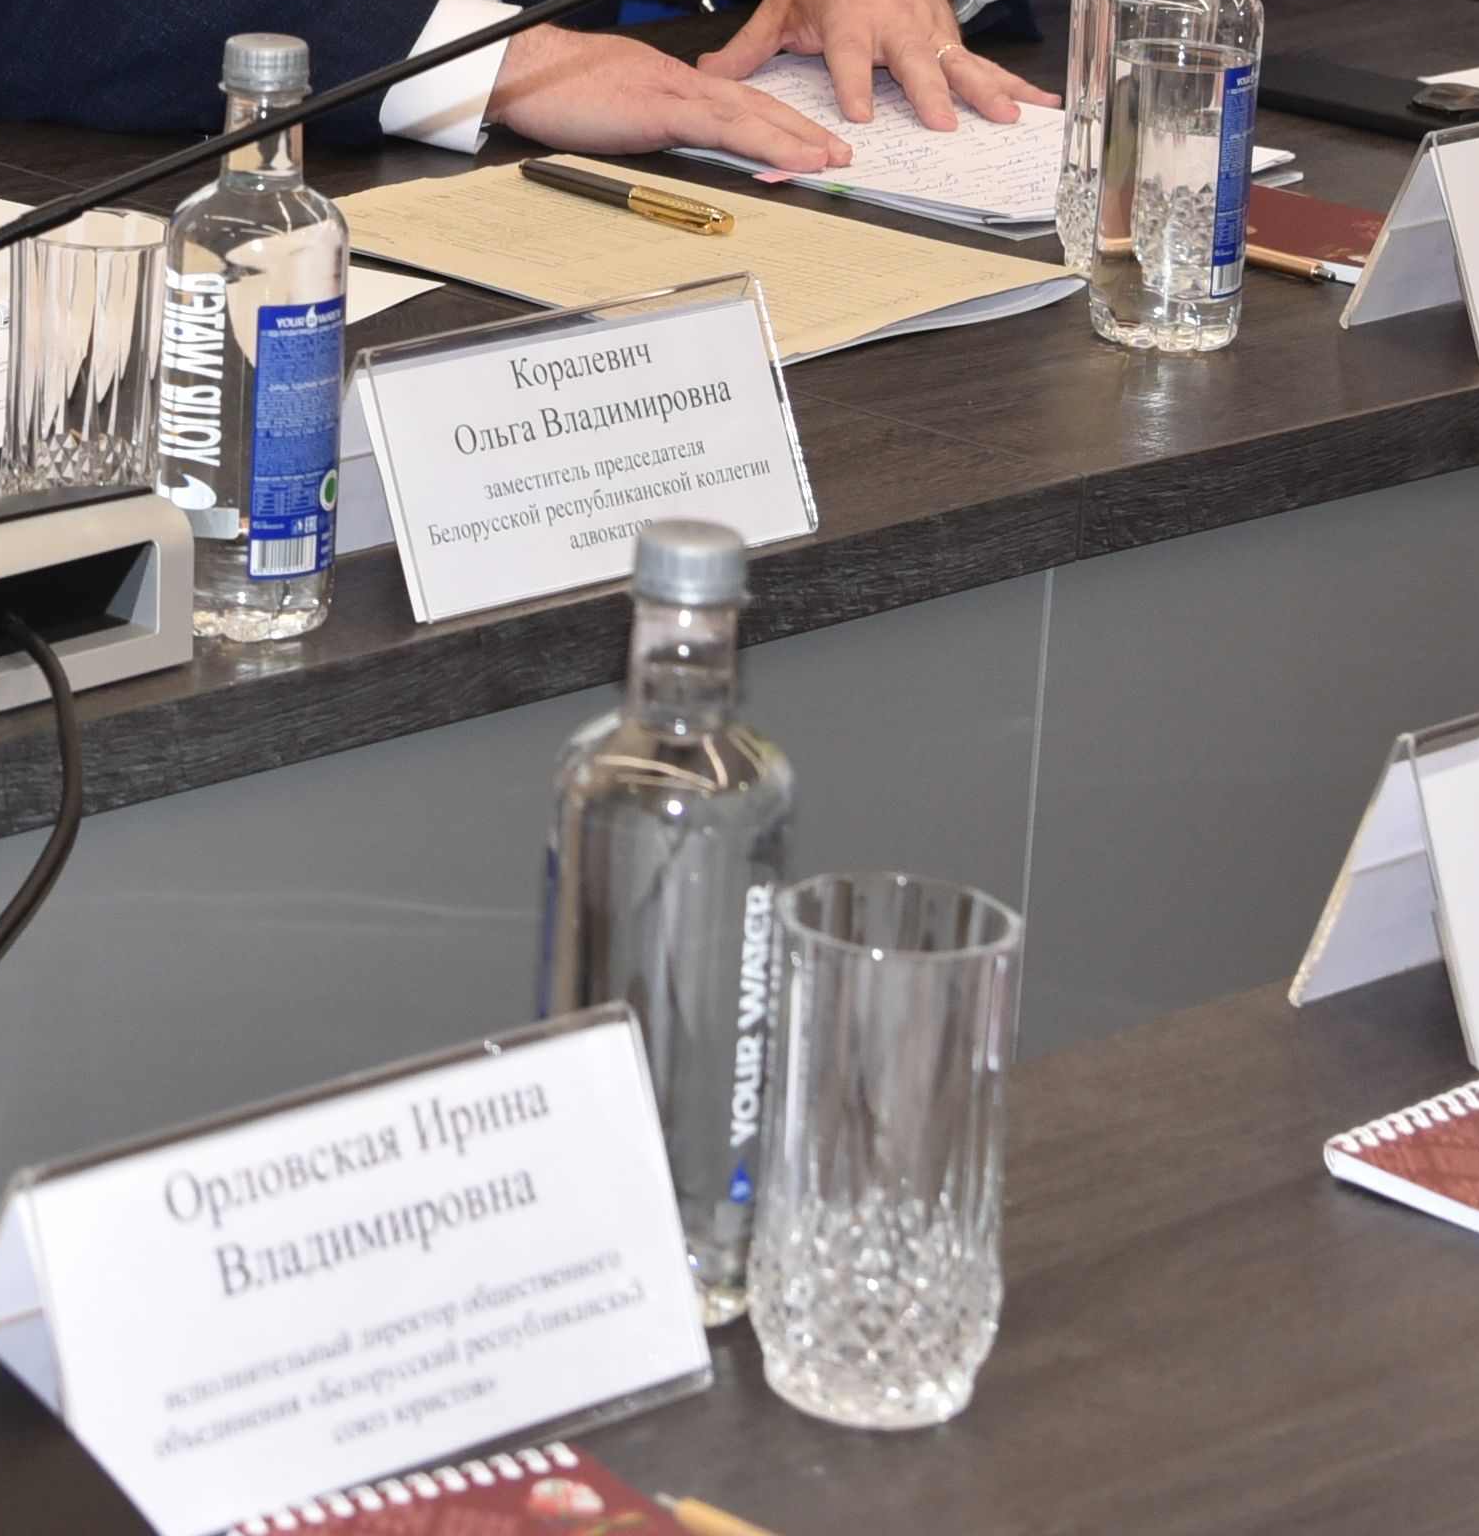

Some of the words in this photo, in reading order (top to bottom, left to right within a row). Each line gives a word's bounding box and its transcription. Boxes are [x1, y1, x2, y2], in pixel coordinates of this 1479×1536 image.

[509, 341, 653, 392] Коралевич
[454, 416, 537, 457] Ольга
[539, 379, 732, 440] Владимировна
[427, 503, 541, 547] Белорусской
[545, 471, 693, 529] республиканской
[696, 457, 771, 491] коллегии
[483, 463, 591, 501] заместитель
[593, 438, 707, 486] председателя
[737, 883, 773, 1030] WATER
[730, 1036, 763, 1148] YOUR
[163, 1122, 403, 1229] Орловская
[410, 1078, 552, 1154] Ирина
[214, 1164, 538, 1298] Владимировна
